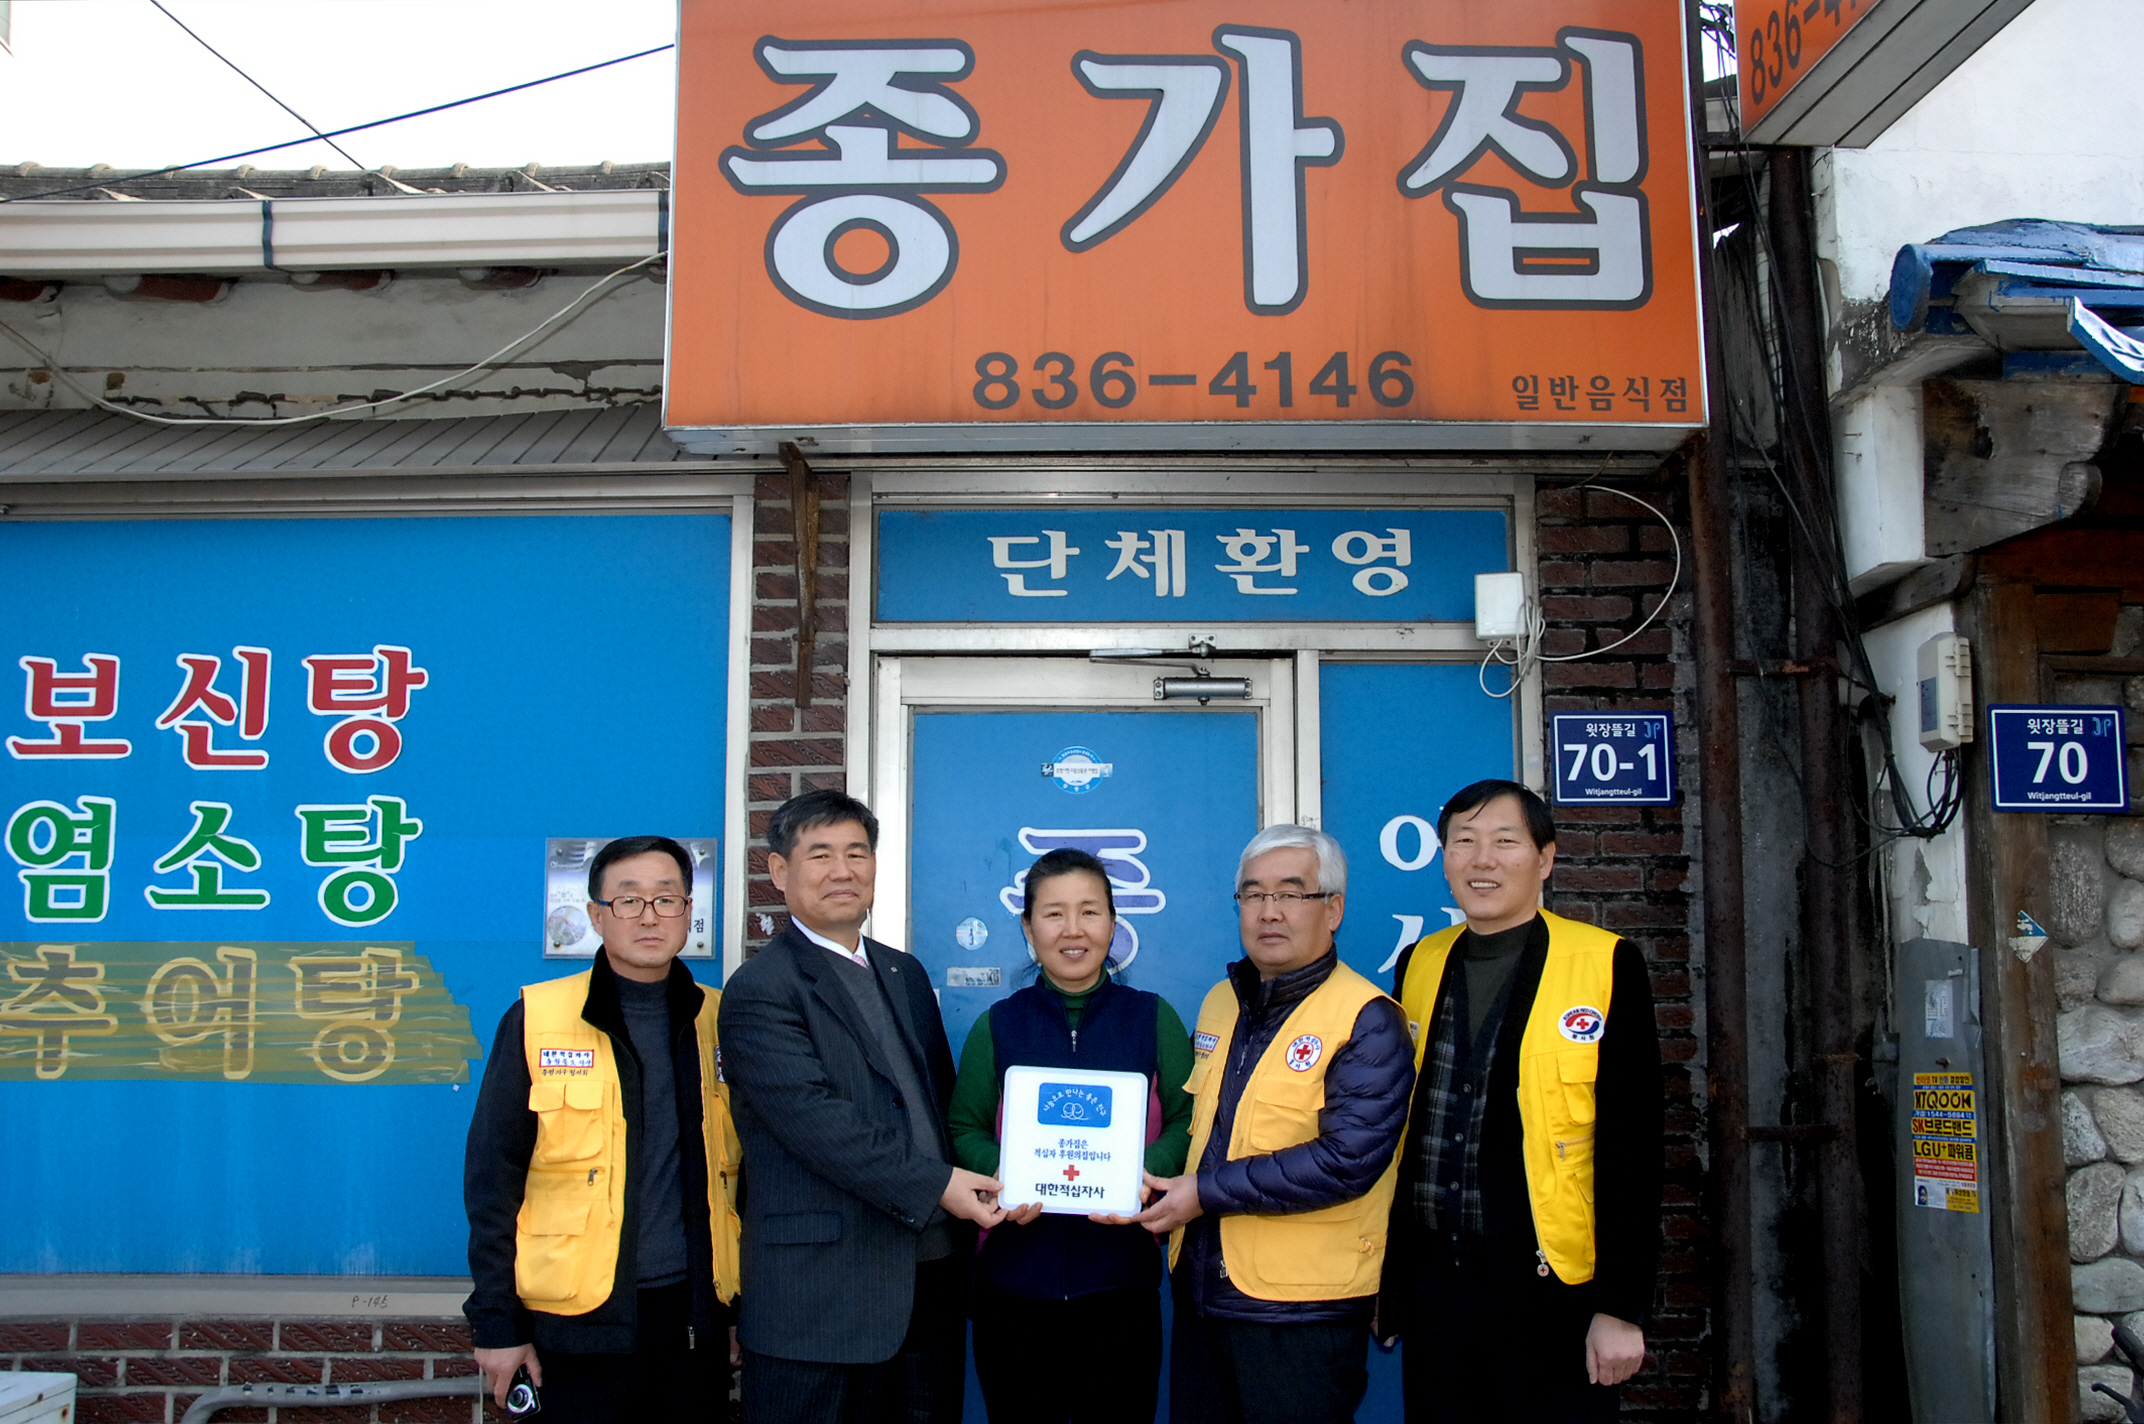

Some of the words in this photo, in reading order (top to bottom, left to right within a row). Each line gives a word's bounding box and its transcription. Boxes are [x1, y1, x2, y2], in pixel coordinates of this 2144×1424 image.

[719, 24, 1654, 320] 종가집
[971, 351, 1416, 410] 836-4146
[1511, 373, 1689, 412] 일반음식점
[987, 527, 1413, 598] 단체환영
[5, 644, 429, 774] 보신탕
[2027, 718, 2084, 735] 윗장뜰길
[1585, 722, 1637, 738] 윗장뜰길
[1563, 742, 1657, 782] 70-1
[2027, 741, 2089, 785] 70
[1585, 788, 1642, 797] Witjangtteul-gil
[2027, 791, 2092, 802] Witjangtteul-gil
[4, 795, 424, 928] 염소탕
[0, 944, 421, 1082] 추어탕
[1034, 1147, 1056, 1159] 적십자
[1058, 1138, 1088, 1149] 종가집은
[1035, 1182, 1105, 1199] 대한적십자사
